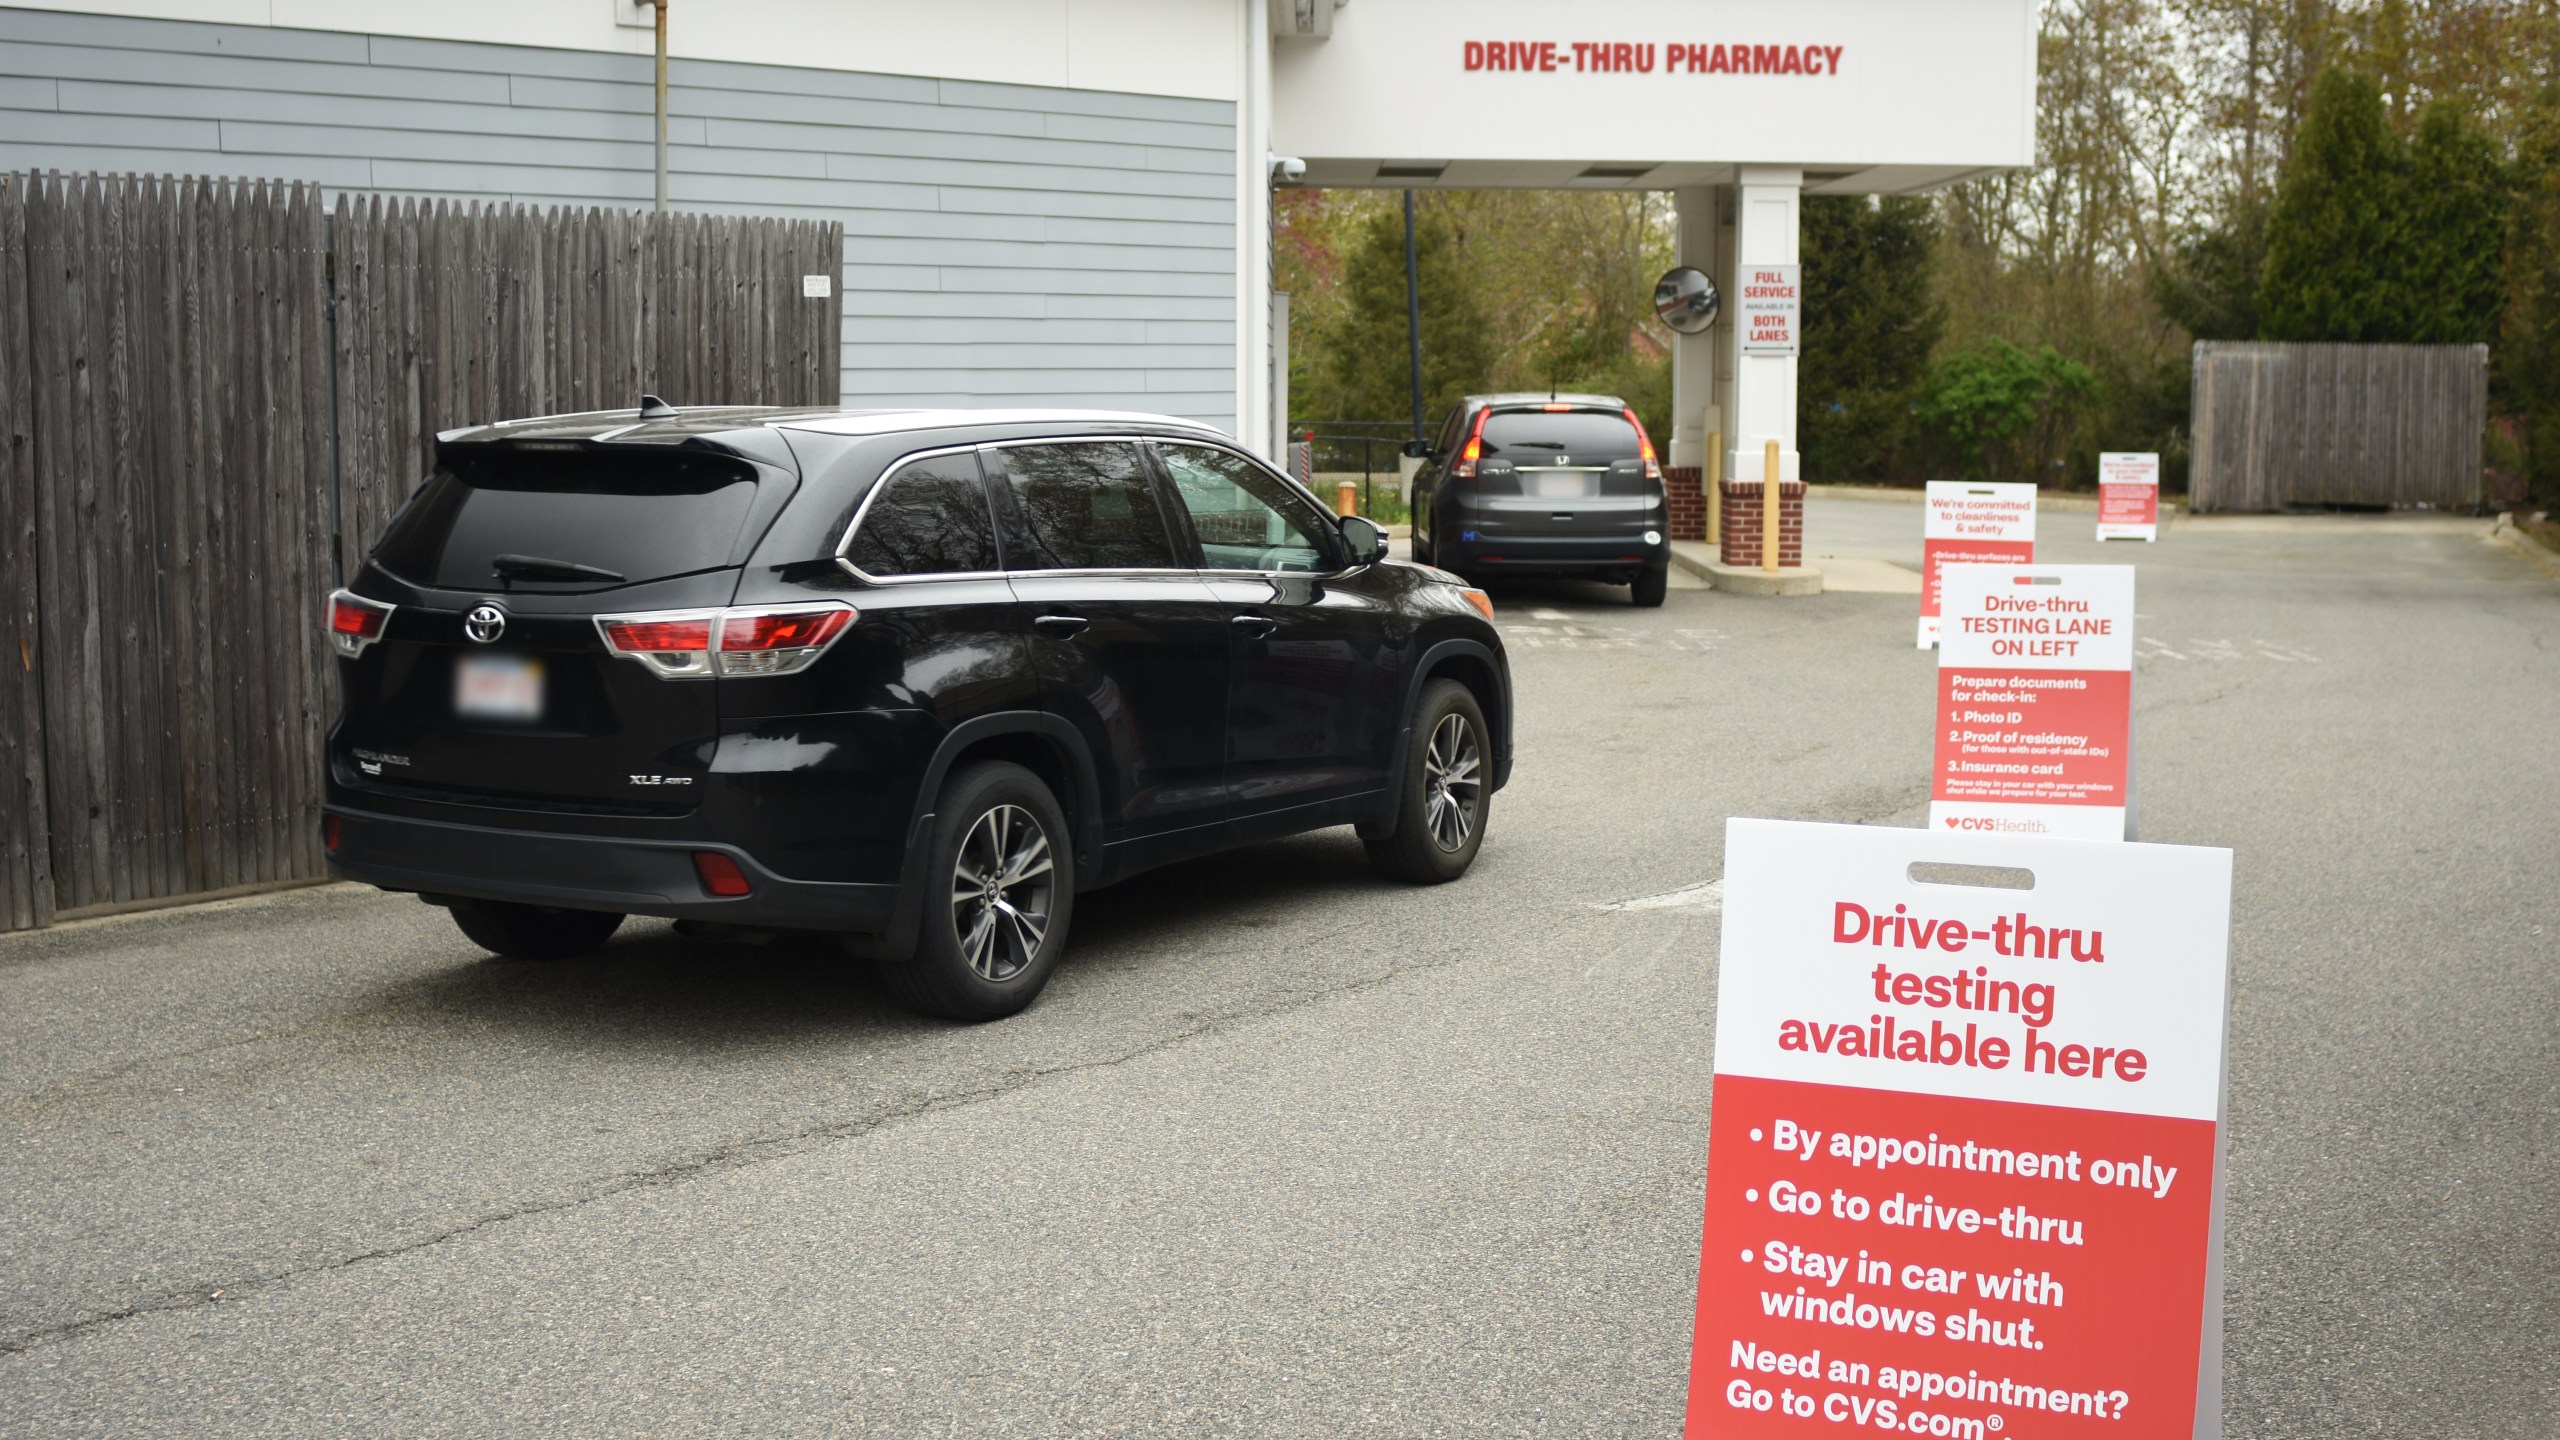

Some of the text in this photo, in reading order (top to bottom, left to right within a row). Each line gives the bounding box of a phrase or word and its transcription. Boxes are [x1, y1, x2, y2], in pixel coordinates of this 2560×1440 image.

[1464, 41, 1843, 75] DRIVE-THRU PHARMACY
[1755, 272, 1784, 283] FULL
[1744, 286, 1795, 298] SERVICE
[1754, 315, 1785, 327] BOTH
[1750, 330, 1789, 341] LANES
[1932, 499, 2030, 511] We're committed
[1941, 511, 2020, 522] to cleanliness
[1955, 523, 2003, 536] & safety
[1985, 595, 2089, 613] Drive-thru
[1961, 617, 2050, 634] TESTING
[2056, 619, 2112, 635] LANE
[1992, 640, 2079, 657] ON LEFT
[1952, 675, 2087, 689] Prepare documents
[1952, 690, 2037, 703] for check-in:
[1951, 711, 2022, 723] 1. Photo ID
[1949, 731, 2087, 748] 2. Proof of residency
[1962, 744, 1979, 753] (for
[1981, 744, 2007, 754] those
[2009, 745, 2029, 754] with
[1948, 760, 2064, 775] 3. Insurance card
[629, 775, 662, 785] XLE
[1946, 778, 1974, 787] Please
[1975, 779, 1992, 788] stay
[2002, 781, 2021, 789] your
[2037, 781, 2054, 789] with
[2056, 783, 2075, 791] your
[2076, 782, 2113, 791] windows
[2036, 789, 2047, 797] for
[2049, 791, 2067, 799] your
[1832, 902, 2105, 963] Drive-thru
[1872, 963, 2056, 1028] testing
[1778, 1015, 2148, 1082] available here
[1773, 1119, 2178, 1199] By appointment only
[1768, 1180, 2084, 1246] Go to drive-thru
[1762, 1241, 2064, 1308] Stay in car with
[1761, 1286, 2045, 1351] windows shut.
[1730, 1340, 2129, 1420] Need an appointment?
[1726, 1379, 1774, 1411] Go
[1781, 1385, 1816, 1418] to
